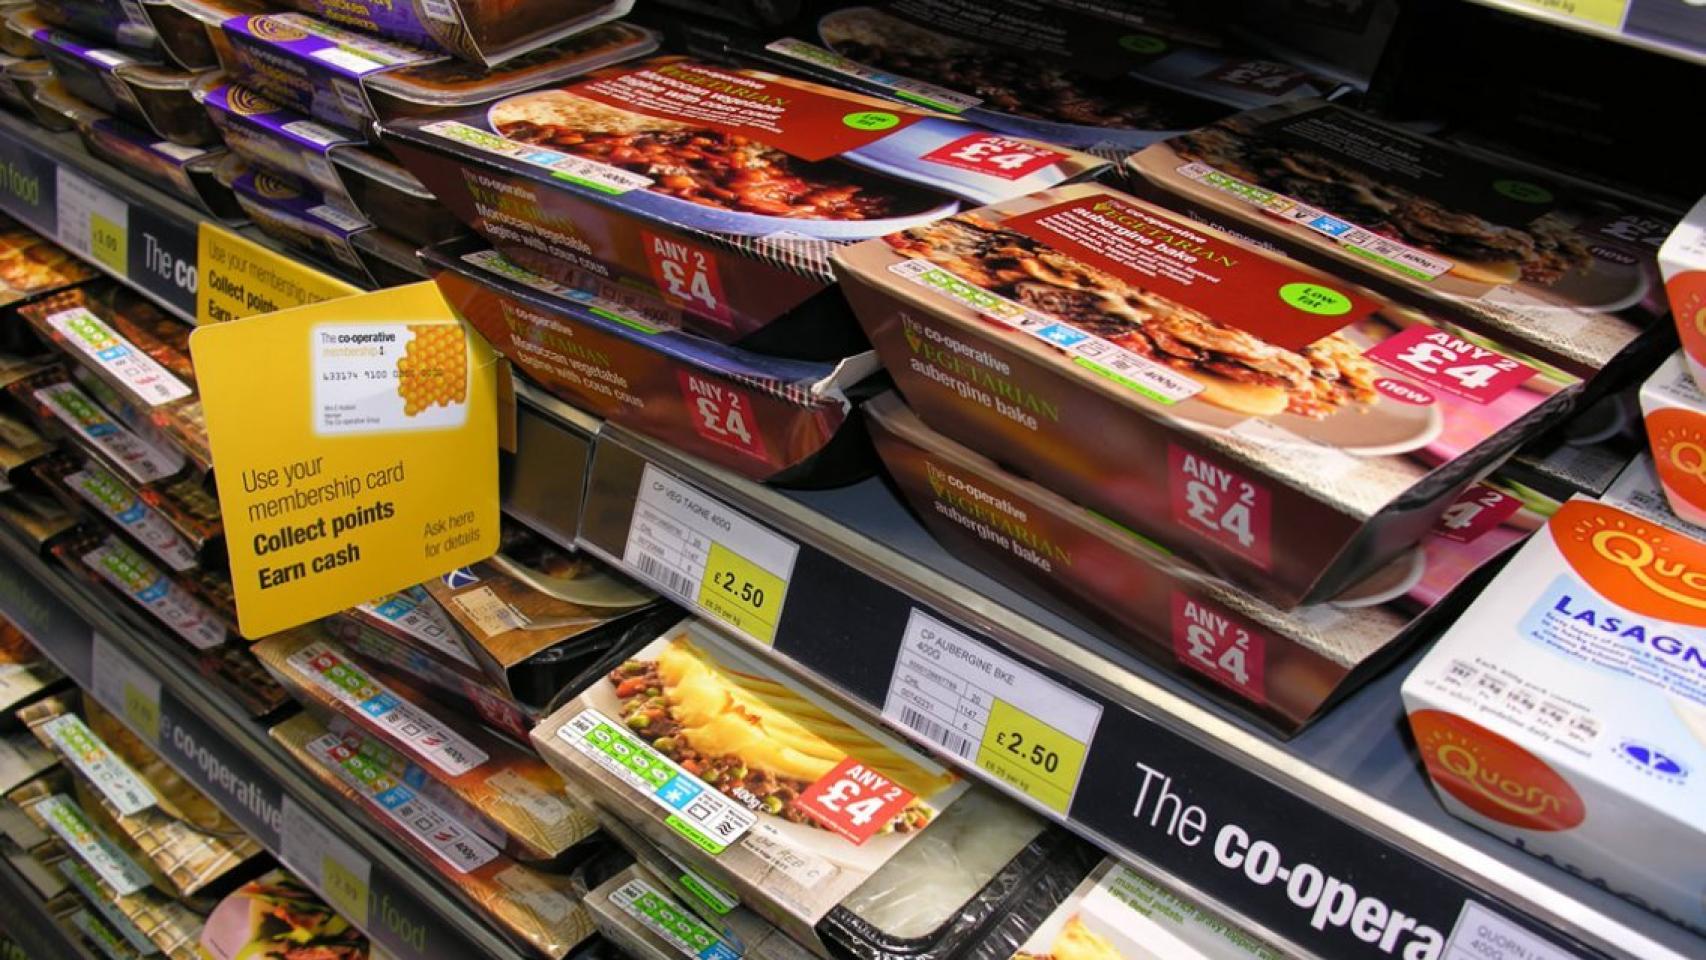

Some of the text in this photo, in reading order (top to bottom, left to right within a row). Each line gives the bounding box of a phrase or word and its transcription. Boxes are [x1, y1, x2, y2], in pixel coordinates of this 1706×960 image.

[856, 117, 878, 127] fat
[863, 113, 888, 123] Low
[951, 142, 1036, 171] £4
[980, 137, 1040, 154] ANY
[9, 162, 39, 207] food
[478, 176, 537, 202] co-operative
[475, 203, 536, 234] Moroccan
[1071, 206, 1154, 246] aubergine
[1152, 243, 1199, 264] bake
[1092, 202, 1239, 268] VEGETARIAN
[1124, 207, 1208, 245] co-operative
[142, 231, 198, 294] The co
[208, 237, 306, 303] Use your membership
[520, 234, 549, 252] with
[548, 245, 579, 264] cous
[579, 257, 609, 277] cous
[654, 238, 708, 271] ANY 2
[1590, 246, 1637, 265] new
[208, 269, 244, 305] Collect
[661, 259, 718, 310] £4
[1296, 295, 1323, 311] fat
[1302, 286, 1339, 307] Low
[320, 331, 397, 345] The co-operative
[901, 311, 1011, 377] The co-operative
[1423, 331, 1520, 374] ANY 2
[510, 332, 629, 389] Moroccan vegetable
[904, 328, 1060, 424] VEGETARIAN
[1396, 341, 1504, 390] £4
[554, 366, 583, 385] with
[582, 376, 613, 397] cous
[614, 389, 646, 409] cous
[688, 376, 742, 410] ANY 2
[909, 356, 1039, 433] aubergine bake
[1378, 379, 1432, 405] new
[696, 396, 753, 445] £4
[241, 456, 325, 494] Use your
[248, 461, 406, 523] membership card
[926, 460, 1028, 525] The co-operative
[1182, 454, 1256, 506] ANY 2
[665, 488, 684, 506] VEG
[927, 466, 1073, 568] VEGETARIAN
[1184, 480, 1256, 549] £4
[1478, 493, 1505, 508] 2
[253, 501, 396, 557] Collect points
[423, 509, 476, 538] Ask here
[424, 525, 481, 559] for details
[934, 499, 1053, 574] aubergine bake
[258, 543, 361, 590] Earn cash
[714, 571, 764, 608] £2.50
[1183, 602, 1251, 651] ANY 2
[1554, 595, 1706, 670] LASAGN
[916, 640, 941, 662] 400G
[920, 628, 935, 641] CP
[934, 636, 994, 675] AUBERGINE
[993, 665, 1017, 687] BKE
[1187, 624, 1250, 687] £4
[996, 731, 1058, 774] £2.50
[173, 725, 283, 833] co-operative
[731, 786, 761, 810] 400g
[845, 763, 905, 803] ANY 2
[1006, 769, 1019, 785] per
[1019, 779, 1030, 793] kg
[1436, 743, 1563, 817] Quorn
[816, 779, 884, 828] £4
[1130, 761, 1207, 848] The
[1213, 823, 1446, 960] co-opera
[382, 893, 426, 954] food
[1476, 924, 1525, 958] QUORN
